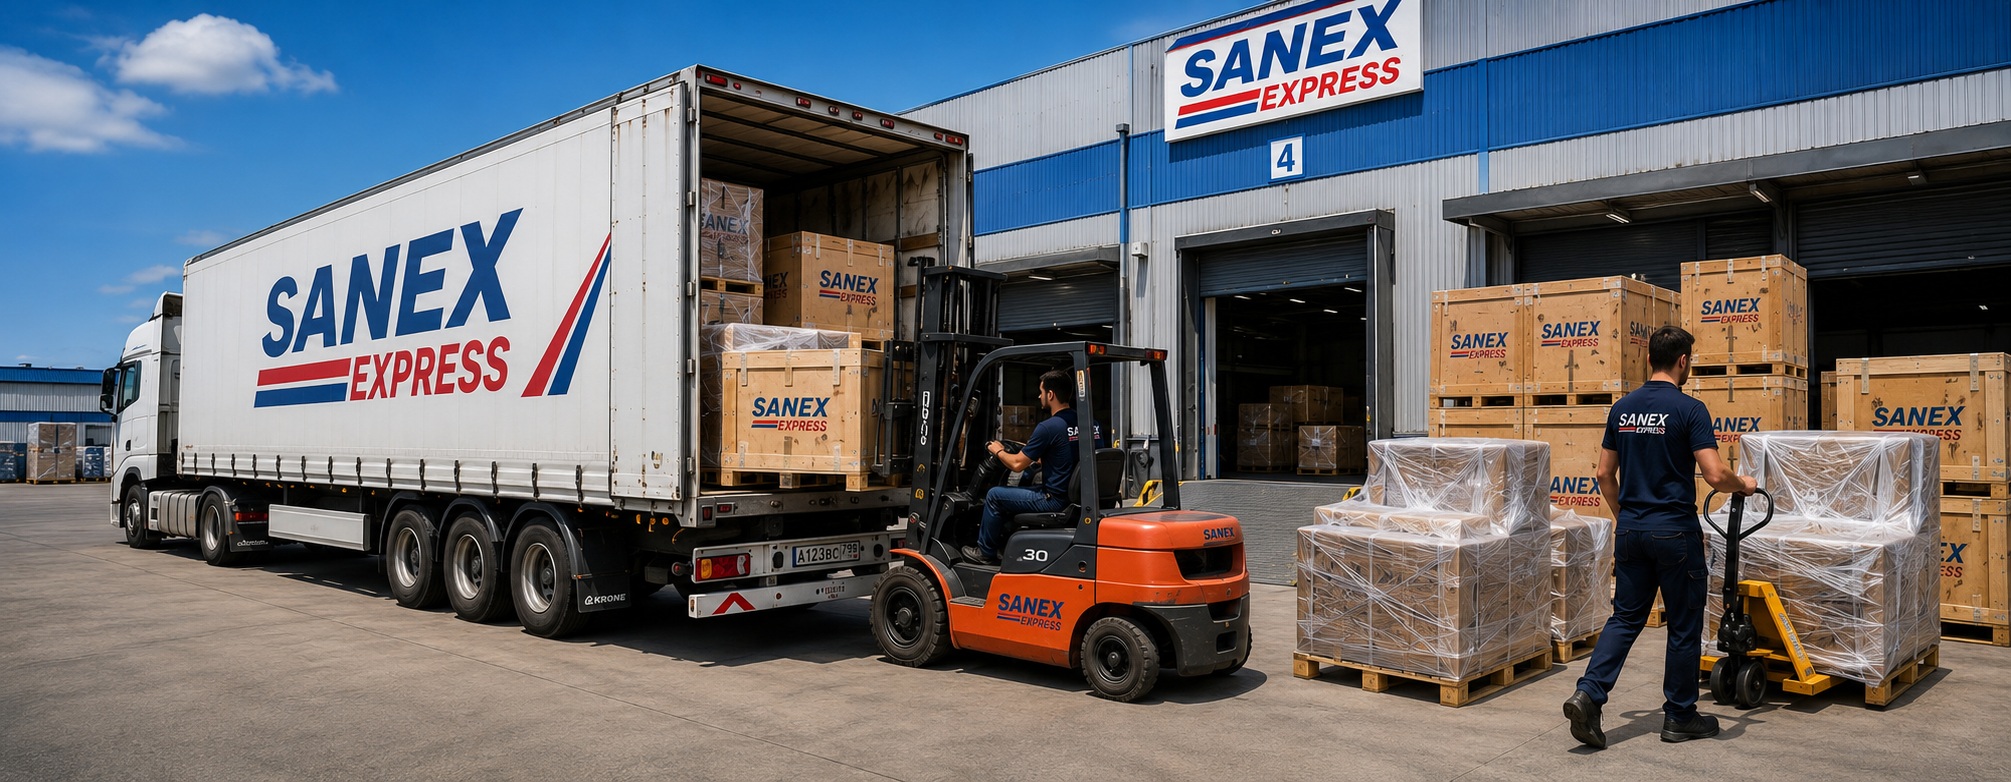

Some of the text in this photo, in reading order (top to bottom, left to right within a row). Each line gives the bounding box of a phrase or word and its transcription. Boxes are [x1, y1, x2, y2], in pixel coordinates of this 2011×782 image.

[1180, 0, 1402, 98] SANEX
[1260, 57, 1401, 111] EXPRESS
[1277, 143, 1295, 172] 4
[701, 213, 749, 236] ANEX
[262, 207, 524, 357] SANEX
[819, 270, 879, 294] SANEX
[1701, 298, 1761, 315] SANEX
[1720, 314, 1759, 324] EXPRESS
[1541, 321, 1601, 339] SANEX
[1450, 332, 1509, 350] SANEX
[1561, 338, 1599, 348] EXPRESS
[350, 336, 511, 401] EXPRESS
[752, 397, 830, 417] SANEX
[778, 420, 828, 431] EXPRESS
[1618, 413, 1669, 427] SANEX
[1711, 417, 1762, 432] ANEX
[1872, 406, 1966, 427] SANEX
[1067, 425, 1100, 437] SAX
[1550, 476, 1601, 495] ANEX
[1558, 496, 1600, 507] EXPRESS
[1203, 527, 1235, 540] SANEX
[1022, 549, 1048, 562] 30
[594, 593, 626, 604] KRONE
[998, 593, 1064, 619] SANEX
[1020, 616, 1062, 631] EXPRESS
